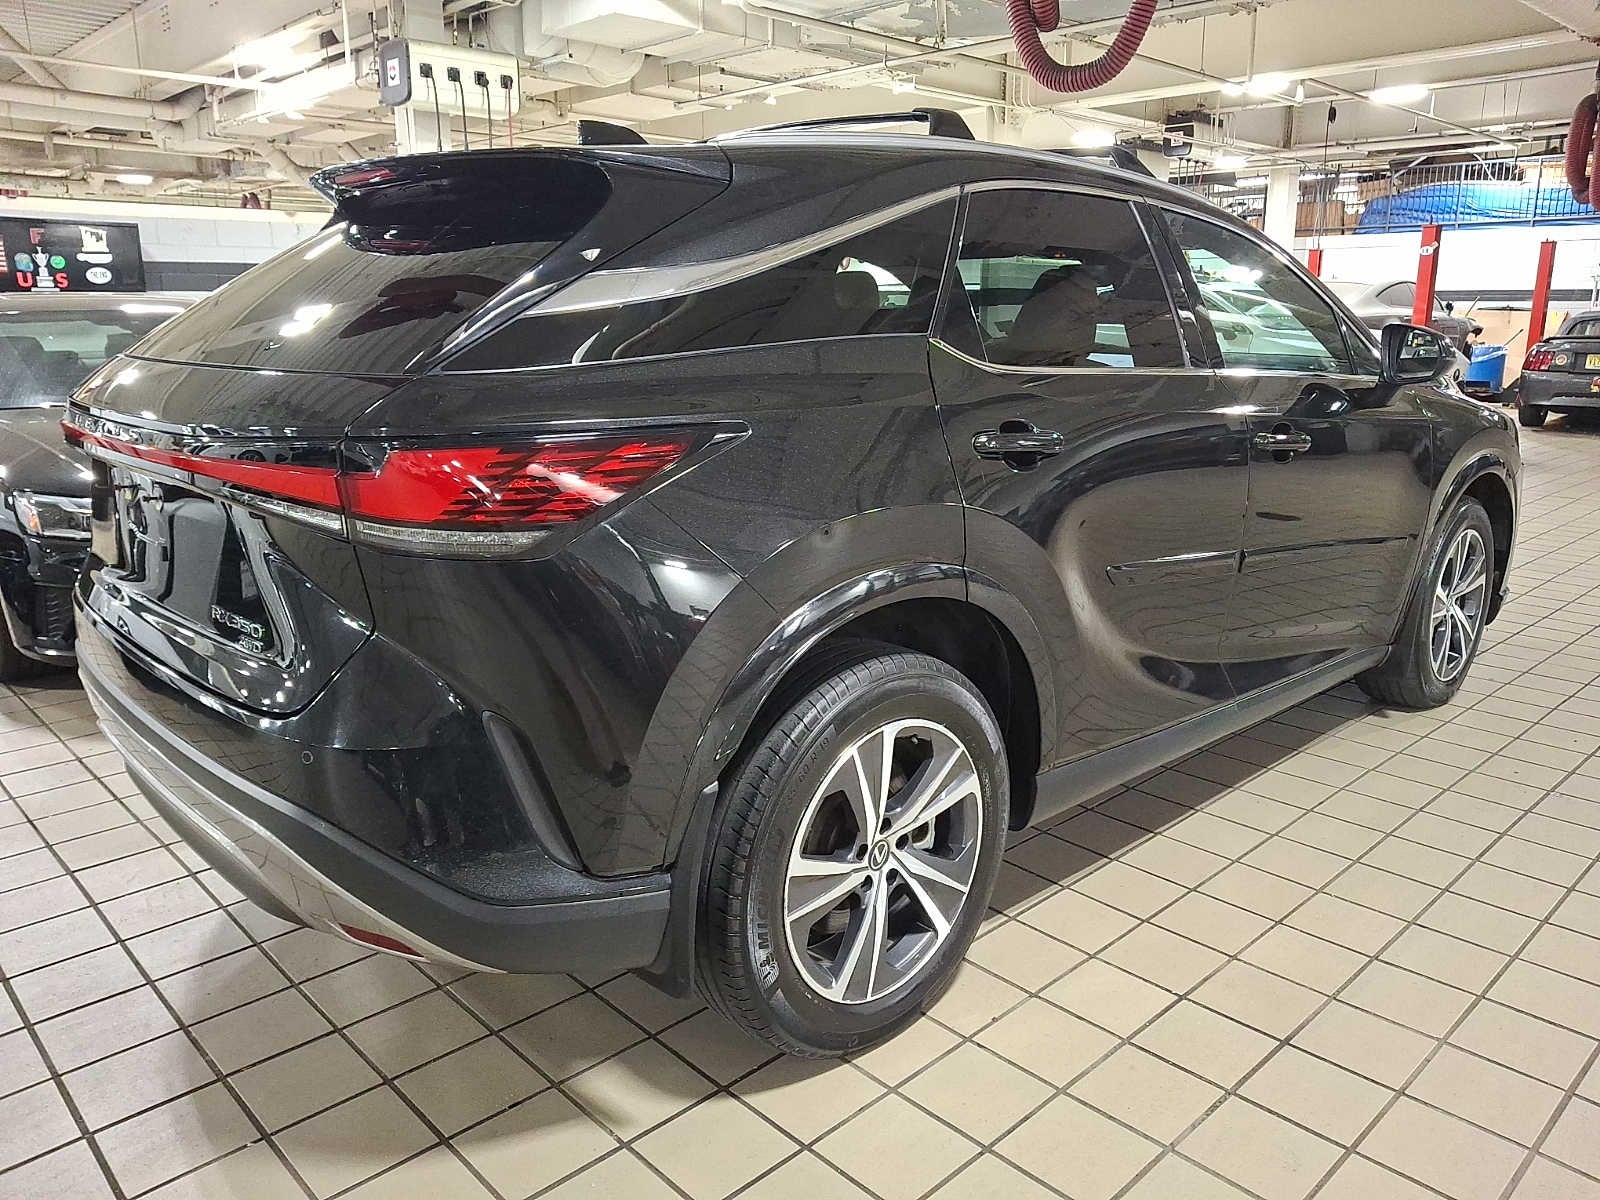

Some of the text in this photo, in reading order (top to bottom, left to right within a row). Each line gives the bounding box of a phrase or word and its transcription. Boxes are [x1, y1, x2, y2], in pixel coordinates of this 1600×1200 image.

[15, 271, 69, 288] U S
[75, 413, 140, 441] LEXUS
[211, 604, 265, 639] RX350
